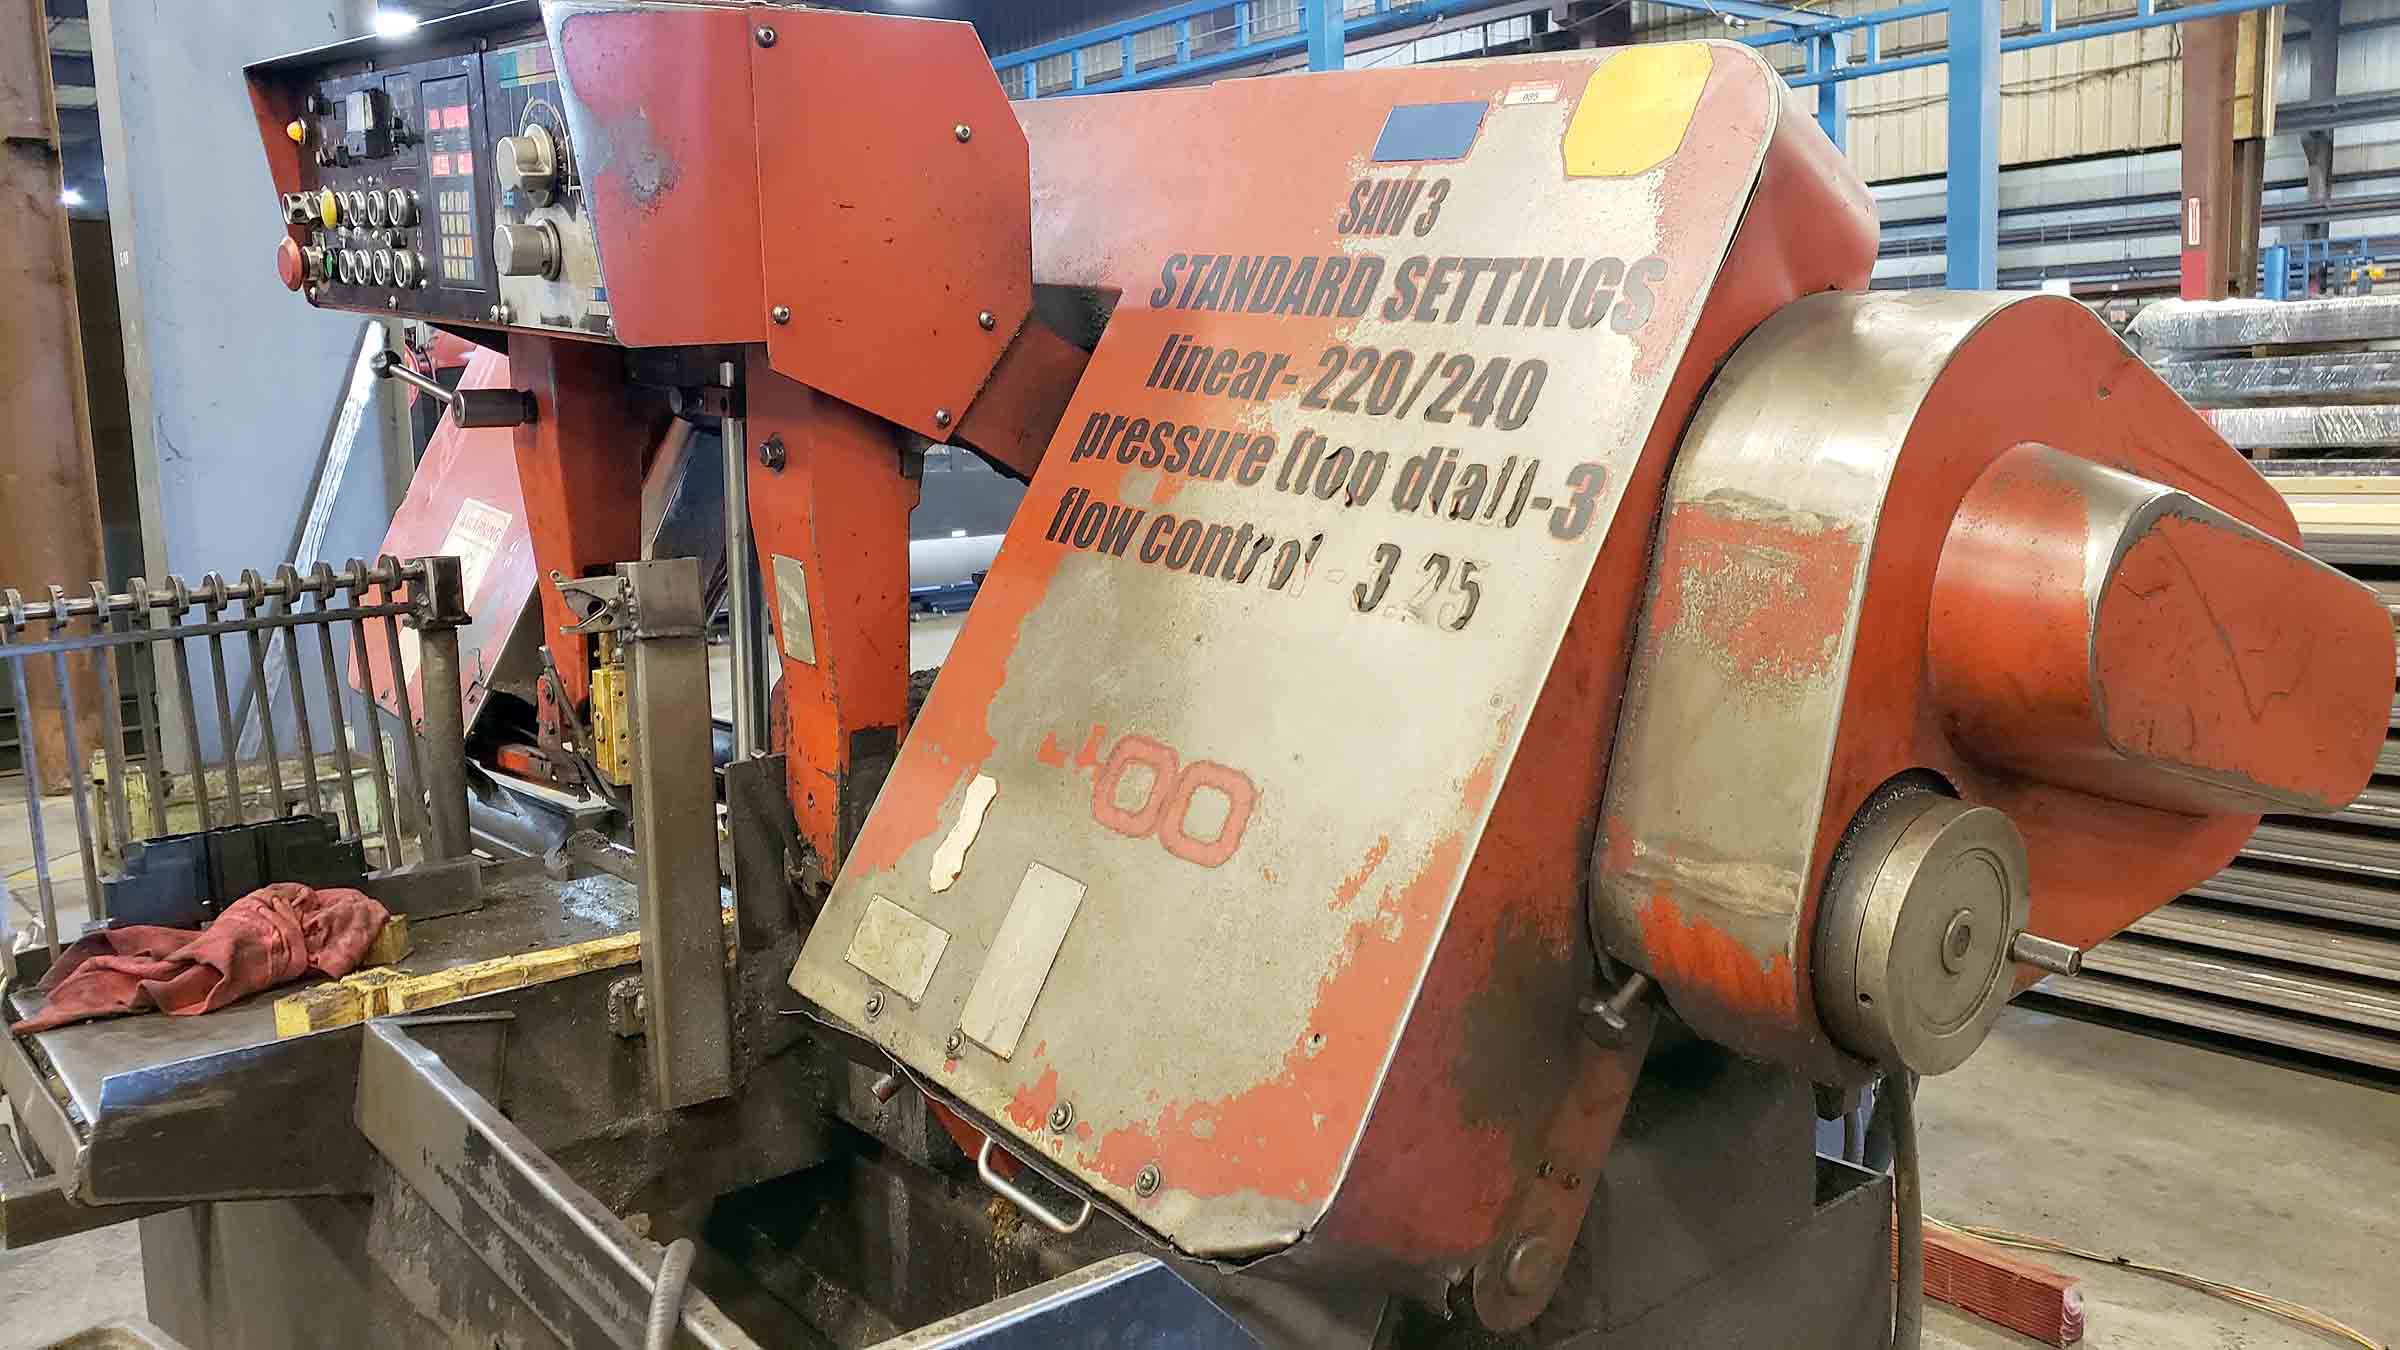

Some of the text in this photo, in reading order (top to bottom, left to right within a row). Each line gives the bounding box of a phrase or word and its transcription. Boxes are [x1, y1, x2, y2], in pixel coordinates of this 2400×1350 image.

[1338, 178, 1451, 238] SAW 3
[1149, 253, 1667, 334] STANDARD SETTINGS
[1143, 332, 1549, 432] linear- 220/240
[1069, 410, 1277, 488] pressure
[1044, 486, 1146, 558] flow
[1138, 512, 1324, 599] control
